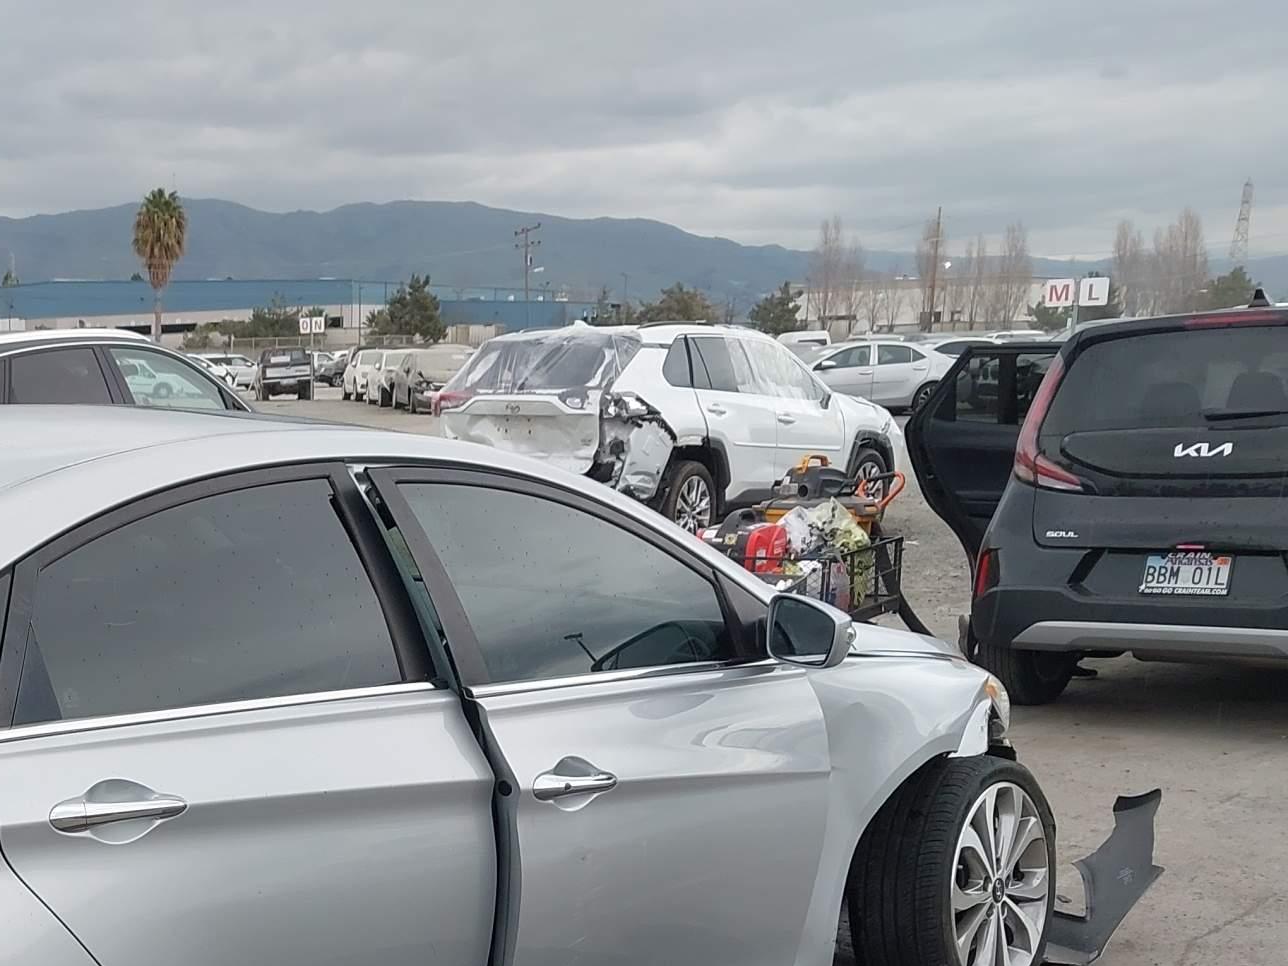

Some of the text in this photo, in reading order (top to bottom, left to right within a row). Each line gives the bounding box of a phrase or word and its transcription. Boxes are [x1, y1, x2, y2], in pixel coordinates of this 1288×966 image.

[1049, 284, 1070, 302] M
[1088, 283, 1100, 301] L
[314, 320, 322, 331] N
[1145, 565, 1180, 585] BBM
